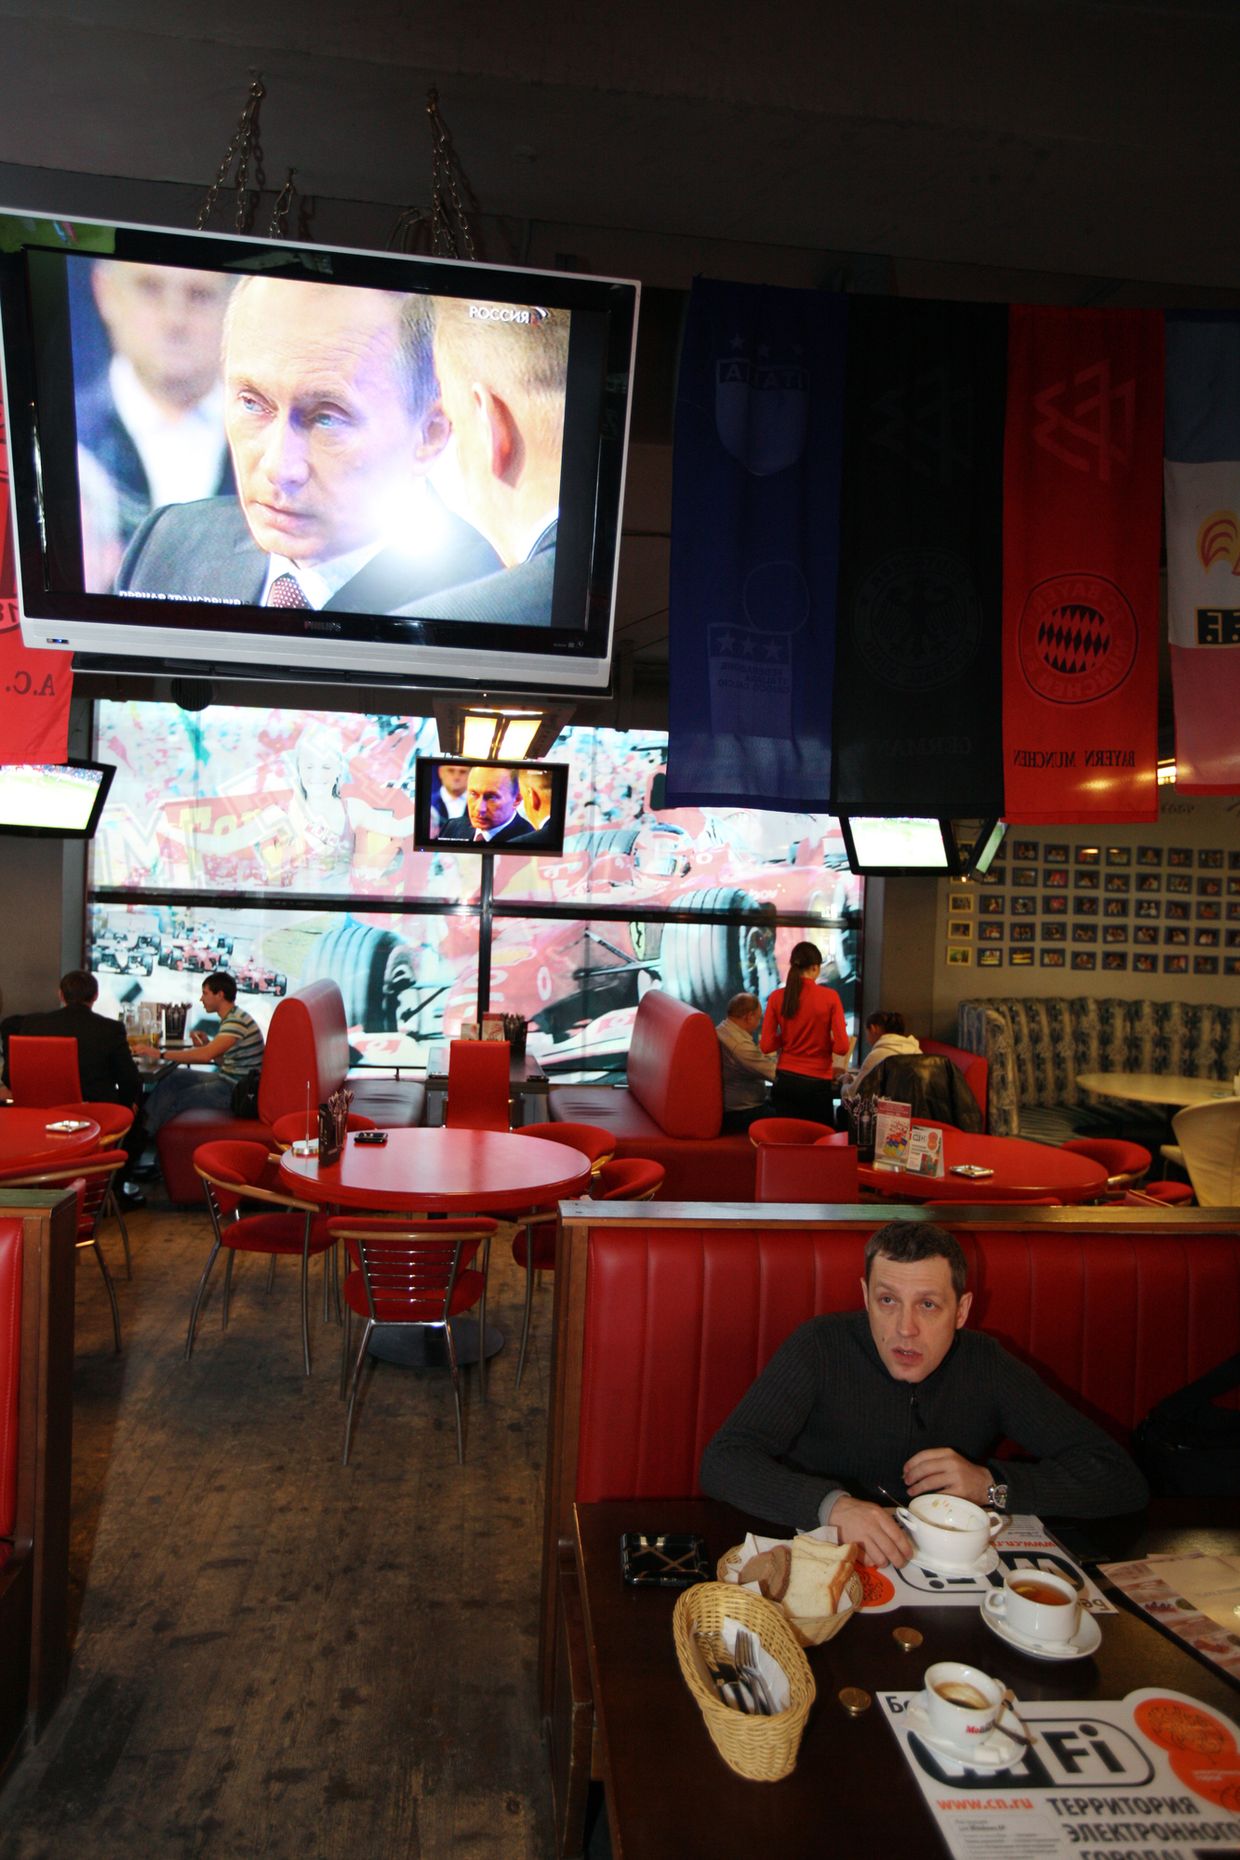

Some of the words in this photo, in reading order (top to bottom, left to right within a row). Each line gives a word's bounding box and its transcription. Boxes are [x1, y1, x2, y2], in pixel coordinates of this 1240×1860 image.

[469, 304, 531, 324] РОССИЯ
[936, 1798, 1034, 1810] www.cn.ru
[1046, 1797, 1200, 1816] ТЕРРИТОРИЯ
[1061, 1822, 1240, 1843] ЭЛЕКТРОННОГО
